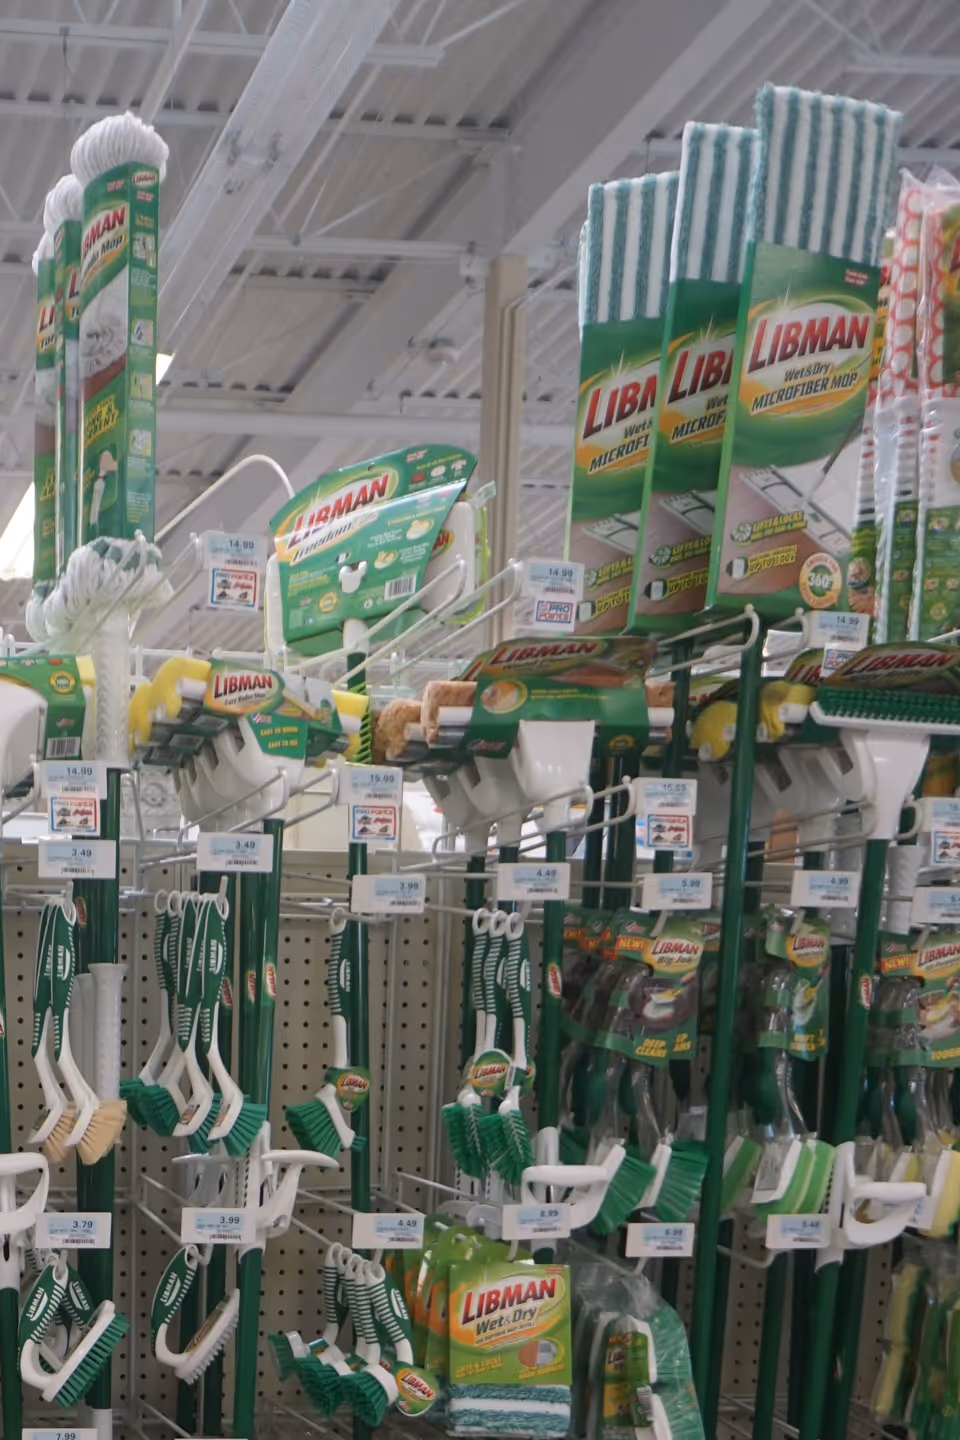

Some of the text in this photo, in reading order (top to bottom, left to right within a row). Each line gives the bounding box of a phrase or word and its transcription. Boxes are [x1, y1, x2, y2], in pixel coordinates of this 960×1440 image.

[748, 313, 870, 374] LIBMAN
[752, 372, 858, 411] MICROFIBER MOP
[489, 641, 599, 666] LIBMAN
[214, 675, 272, 699] LIBMAN
[66, 767, 93, 776] 14.99
[235, 840, 256, 850] 3.49
[71, 849, 92, 858] 3.49
[537, 868, 557, 878] 4.49
[399, 882, 419, 891] 3.99
[652, 941, 699, 956] LIBMAN
[793, 936, 825, 951] LIBMAN
[209, 939, 217, 971] LIBMAN
[475, 1065, 506, 1080] LIBMAN
[73, 1220, 93, 1228] 3.79
[219, 1216, 240, 1224] 3.99
[398, 1220, 417, 1228] 4.49
[72, 1280, 90, 1311] LIBMAN
[160, 1272, 178, 1304] LIBMAN
[26, 1287, 45, 1318] LIBMAN
[394, 1289, 409, 1320] LIBMAN
[462, 1278, 556, 1325] LIBMAN
[401, 1372, 433, 1398] LIBMAN
[56, 1433, 76, 1440] 7.99
